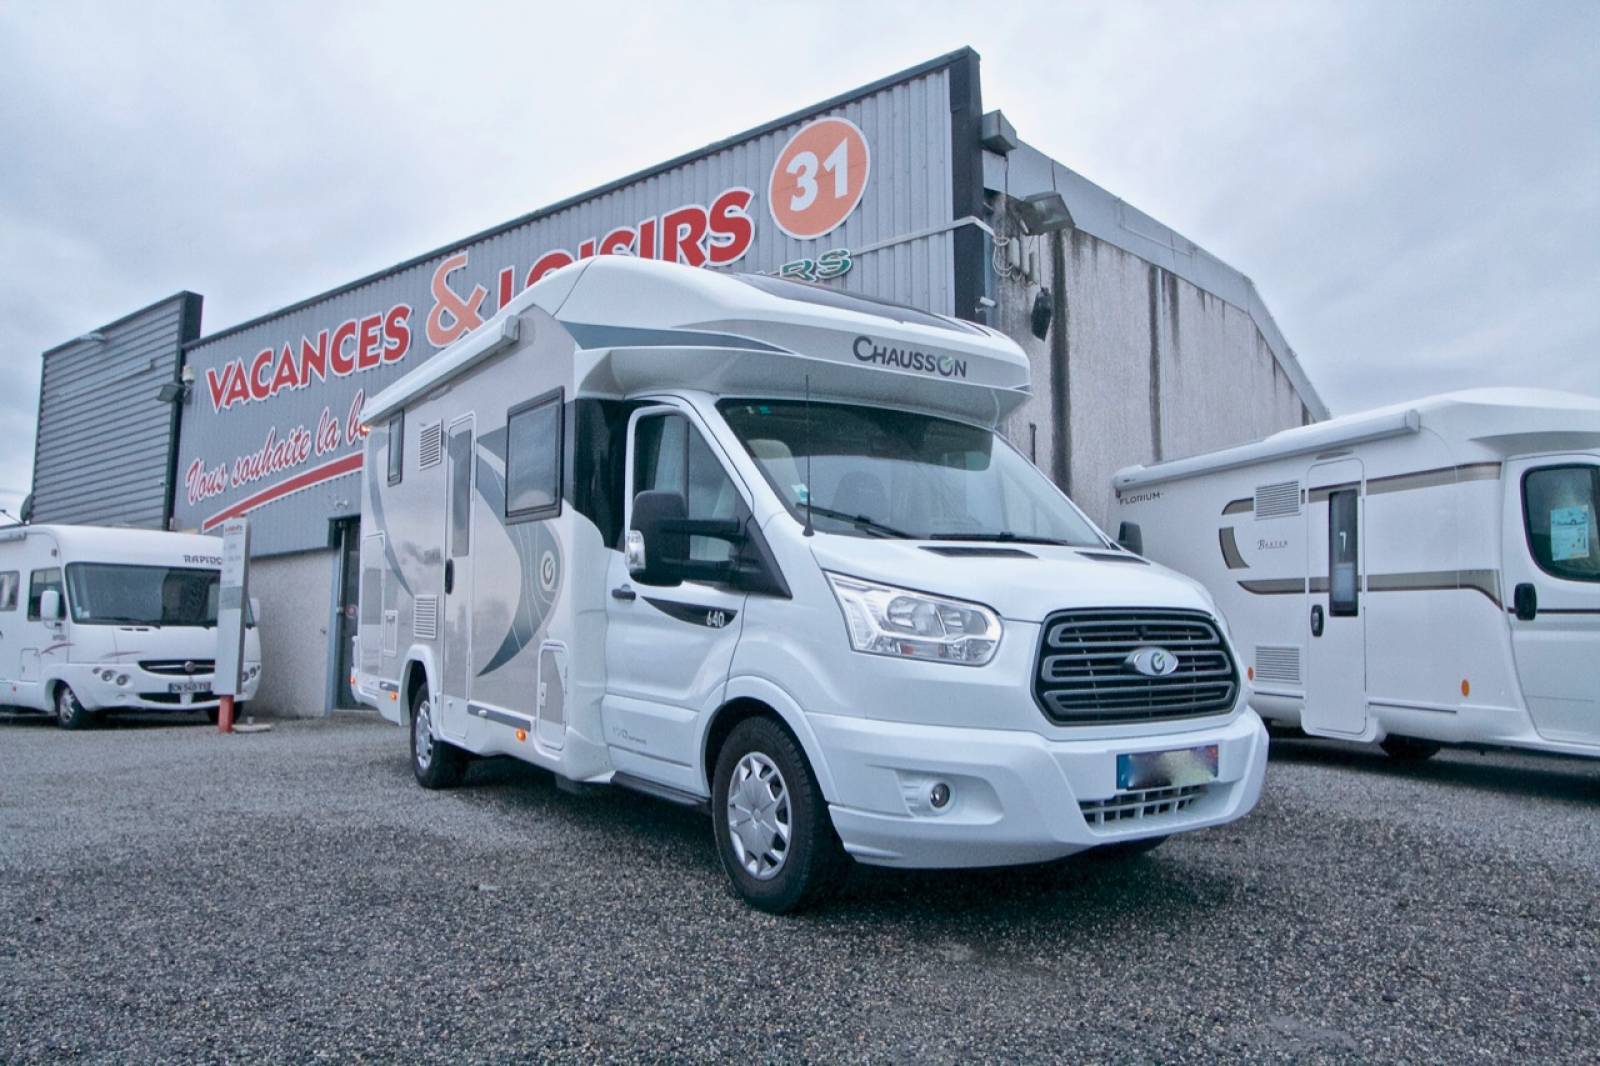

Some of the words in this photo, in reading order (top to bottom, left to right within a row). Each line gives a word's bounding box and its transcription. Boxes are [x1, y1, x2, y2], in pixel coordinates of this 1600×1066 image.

[206, 303, 413, 414] VACANCES
[426, 251, 488, 348] &
[785, 137, 849, 212] 31
[852, 335, 967, 378] CHAUSSON
[185, 457, 228, 506] Vous
[230, 426, 312, 488] souhaite
[314, 406, 342, 456] la
[705, 609, 725, 628] 640
